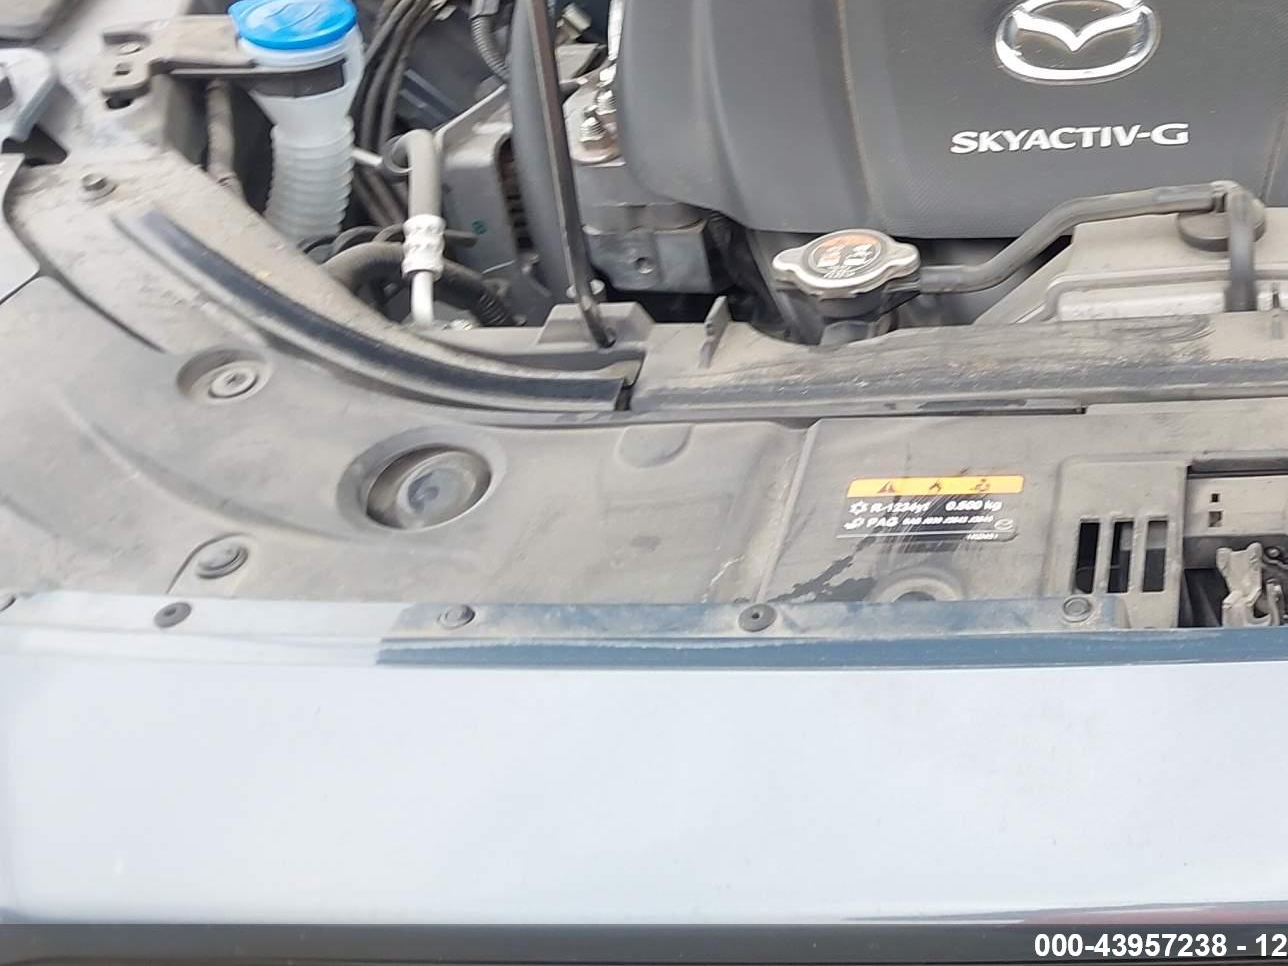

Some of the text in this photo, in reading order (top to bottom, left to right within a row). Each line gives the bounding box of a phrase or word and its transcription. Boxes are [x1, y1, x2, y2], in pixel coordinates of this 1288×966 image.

[950, 123, 1190, 154] SKYACTIV-G
[983, 499, 1003, 512] kg
[866, 516, 899, 528] PAG
